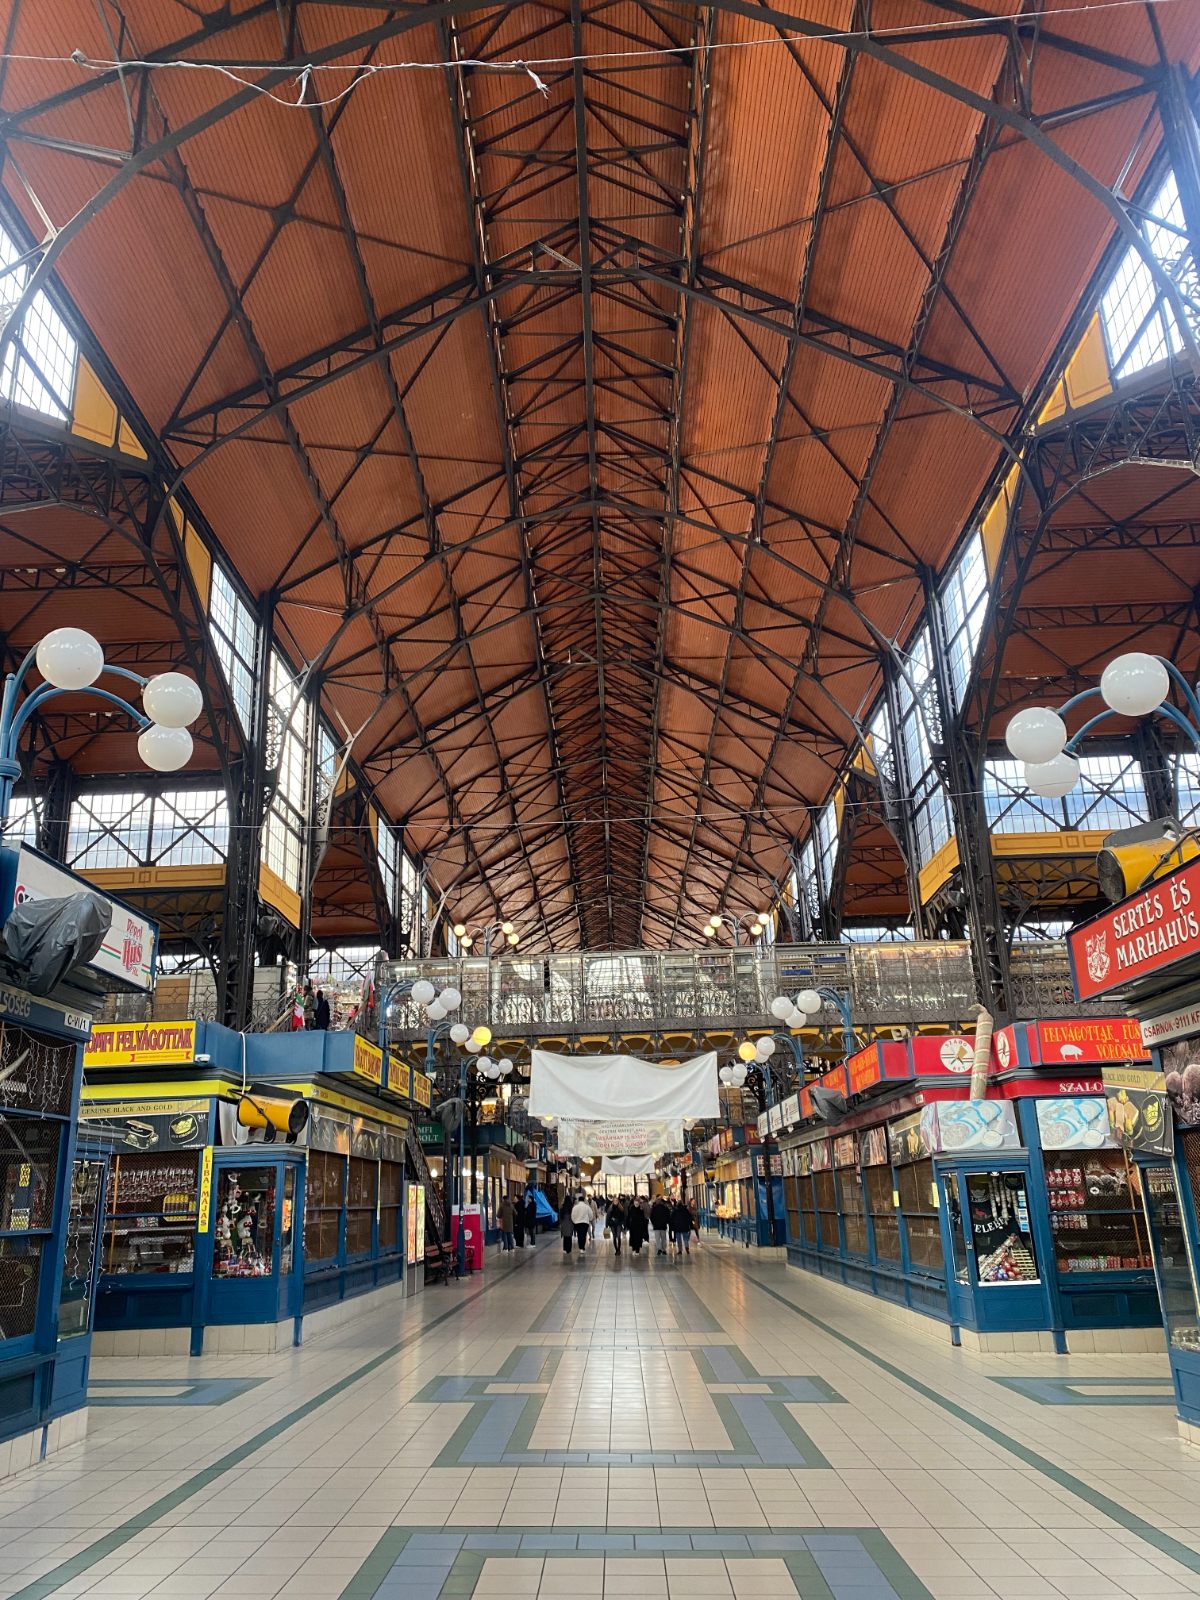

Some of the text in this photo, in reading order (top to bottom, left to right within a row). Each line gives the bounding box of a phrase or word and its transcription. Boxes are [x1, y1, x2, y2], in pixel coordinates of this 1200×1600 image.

[1112, 876, 1191, 940] SERTÉS ÉS
[1115, 909, 1199, 971] MARHAHÚS
[84, 1024, 193, 1054] OMFI FELVÁGOTTAK
[1043, 1023, 1115, 1043] FELVÁGOTTAK
[81, 1107, 111, 1115] GENUINE
